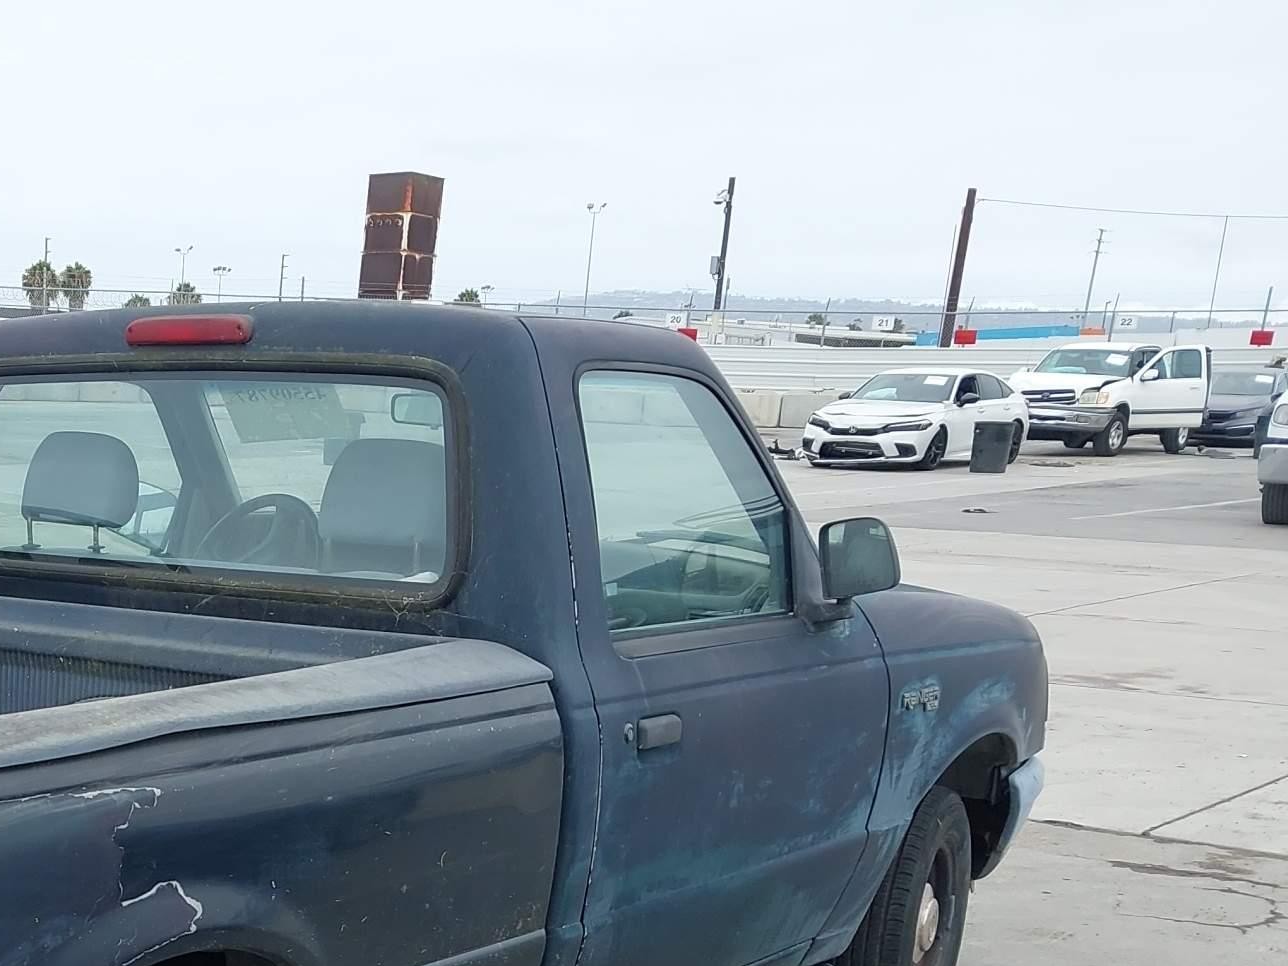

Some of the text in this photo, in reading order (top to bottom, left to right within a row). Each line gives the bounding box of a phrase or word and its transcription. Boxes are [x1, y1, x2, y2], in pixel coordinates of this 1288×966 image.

[670, 315, 682, 324] 20
[878, 318, 889, 327] 21
[1120, 318, 1133, 326] 22
